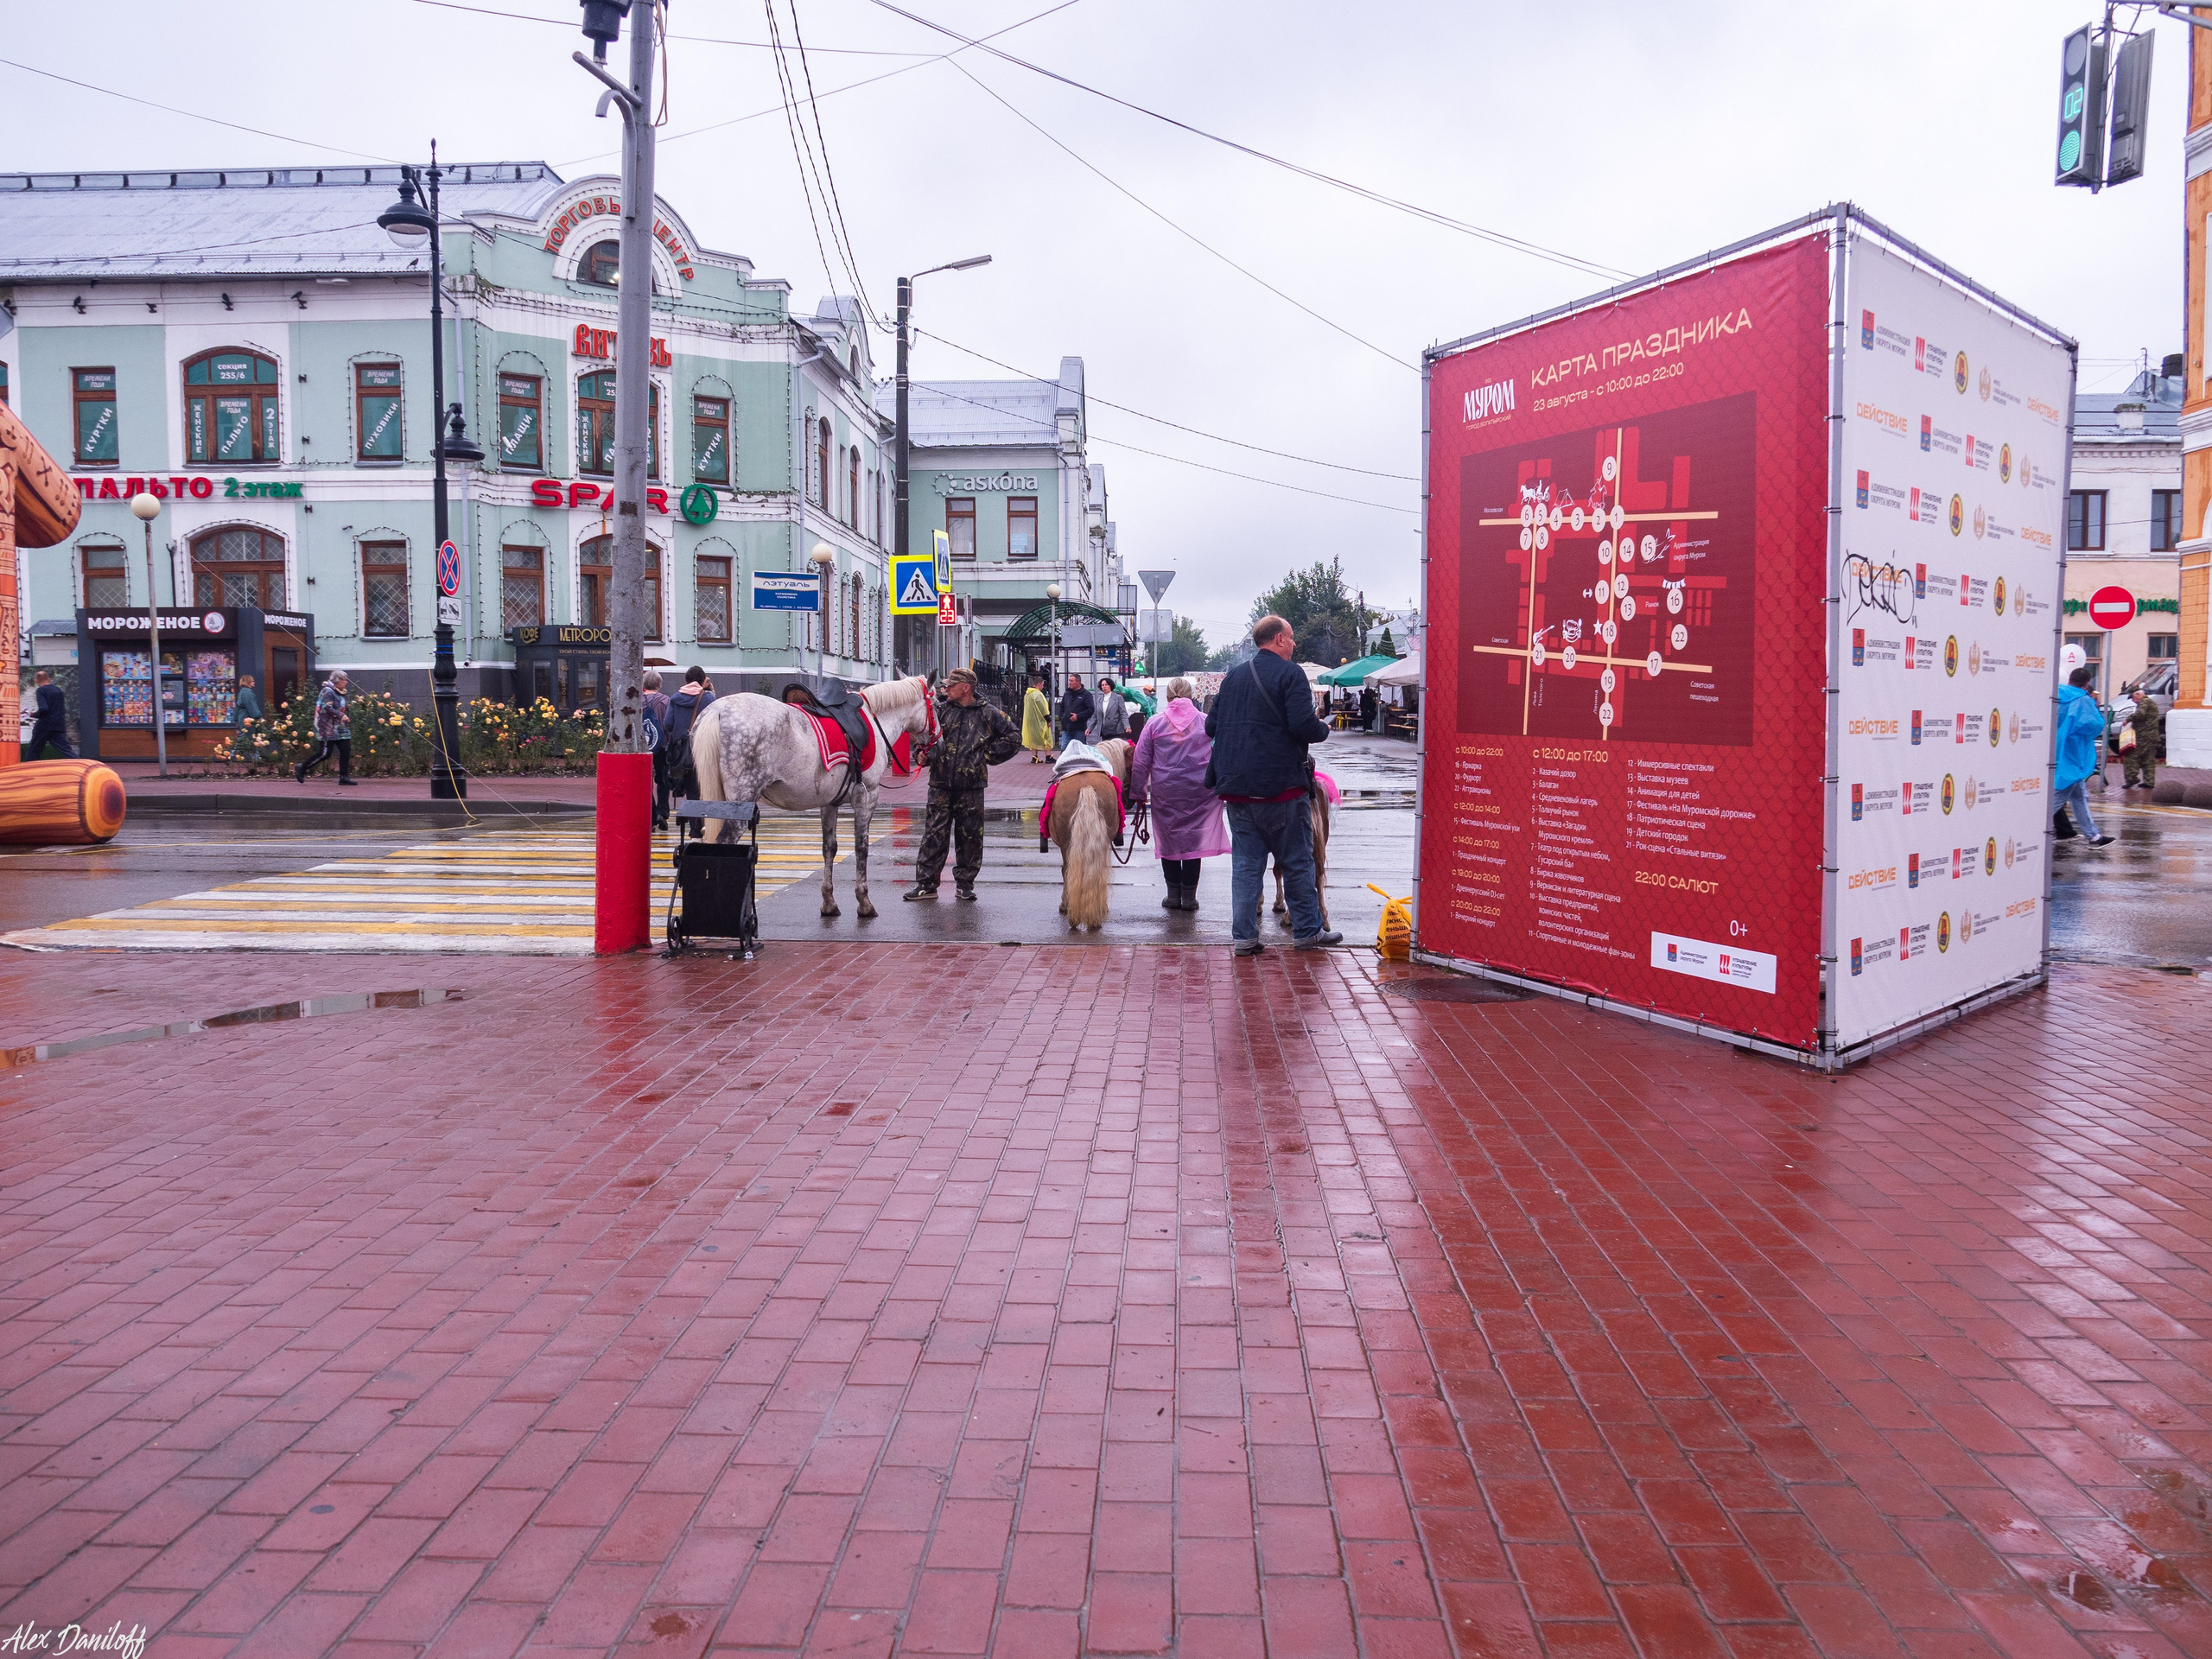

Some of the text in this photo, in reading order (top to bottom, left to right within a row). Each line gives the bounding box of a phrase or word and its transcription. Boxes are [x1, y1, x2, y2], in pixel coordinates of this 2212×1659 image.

[2064, 86, 2084, 119] 02
[543, 196, 620, 253] ТОРГОВЫ
[1531, 307, 1753, 389] КАРТА ПРАЗДНИКА
[217, 363, 247, 372] секция
[219, 372, 245, 380] 255/6
[1533, 361, 1684, 412] 23 августа с 10:00 до 22:00
[1462, 378, 1516, 423] МУРОМ
[265, 408, 275, 420] 2
[2027, 397, 2059, 422] ДЕЙСТВИЕ
[1480, 413, 1512, 428] БОГАТЫРСКИЙ
[1857, 402, 1908, 432] ДЕЙСТВИЕ
[85, 407, 113, 453] КУРТКИ
[194, 404, 202, 454] ЖЕНСКИЕ
[364, 402, 399, 450] ПУХОВИКИ
[220, 415, 249, 454] ПАЛЬТО
[697, 432, 722, 472] КУРТКИ
[1606, 462, 1612, 476] 9
[73, 476, 303, 499] ПАЛЬТО 2 этаж
[963, 474, 1039, 492] askona
[1524, 509, 1529, 521] 6
[1538, 509, 1543, 522] 5
[1553, 515, 1559, 526] 4
[1575, 513, 1580, 527] 3
[1596, 515, 1601, 525] 2
[1614, 512, 1618, 523] 1
[1523, 533, 1529, 545] 7
[1540, 532, 1545, 544] 8
[2020, 525, 2052, 546] ДЕЙСТВИЕ
[1623, 544, 1632, 557] 14
[1644, 542, 1653, 556] 15
[1673, 539, 1710, 550] Администрация
[1601, 547, 1610, 557] 10
[1688, 551, 1707, 561] Муром
[1598, 587, 1605, 597] 11
[1617, 581, 1625, 591] 12
[1670, 593, 1680, 607] 16
[1624, 603, 1632, 617] 13
[2137, 598, 2178, 617] рмац
[87, 616, 200, 630] МОРОЖЕНОЕ
[264, 614, 307, 627] МОРОЖЕНОЕ
[939, 610, 955, 623] 23
[519, 627, 539, 639] КОФЕ
[559, 627, 612, 642] METROPO
[1605, 625, 1614, 638] 18
[1675, 632, 1685, 642] 22
[1535, 650, 1542, 659] 21
[1566, 652, 1574, 663] 20
[2015, 652, 2045, 669] ДЕЙСТВИЕ
[1649, 658, 1658, 671] 17
[1604, 676, 1613, 690] 19
[1690, 680, 1715, 690] Советская
[1602, 709, 1611, 720] 22
[1848, 716, 1898, 734] ДЕЙСТВИЕ
[1461, 746, 1476, 754] 10:00
[1486, 747, 1503, 757] 22:00
[1533, 747, 1608, 763] с 12:00 до 17:00
[1538, 766, 1577, 779] Казачий дозор
[1637, 759, 1714, 772] Иммерсивные спектакли
[1538, 779, 1559, 789] Балаган
[1637, 772, 1689, 786] Выставка музеев
[2011, 777, 2040, 792] ДЕЙСТВИЕ
[1538, 792, 1599, 808] Средневековый лагерь
[1637, 786, 1700, 800] Анимация для детей
[1459, 802, 1474, 811] 12:00
[1484, 804, 1500, 814] 14:00
[1538, 804, 1580, 817] Толкучий рынок
[1637, 800, 1756, 820] Фестиваль «На Муромской дорожке»
[1637, 813, 1706, 830] Патриотическая сцена
[1636, 827, 1688, 843] Детский городок
[1459, 836, 1473, 845] 14:00
[1484, 839, 1499, 849] 17:00
[1537, 842, 1610, 861] Театр под открытым небом,
[1635, 841, 1727, 861] Рок-сцена «Стальные витязи»
[1537, 855, 1574, 868] Гусарский бал
[1457, 868, 1472, 879] 19:00
[1482, 873, 1500, 884] 20:00
[1635, 870, 1719, 894] 22:00 САЛЮТ
[1848, 865, 1897, 890] ДЕЙСТВИЕ
[1536, 880, 1621, 903] Вернисаж литературная сцена
[1456, 899, 1472, 911] 20:00
[1483, 906, 1501, 916] 22:00
[2005, 897, 2036, 918] ДЕЙСТВИЕ
[1730, 919, 1748, 937] 0+
